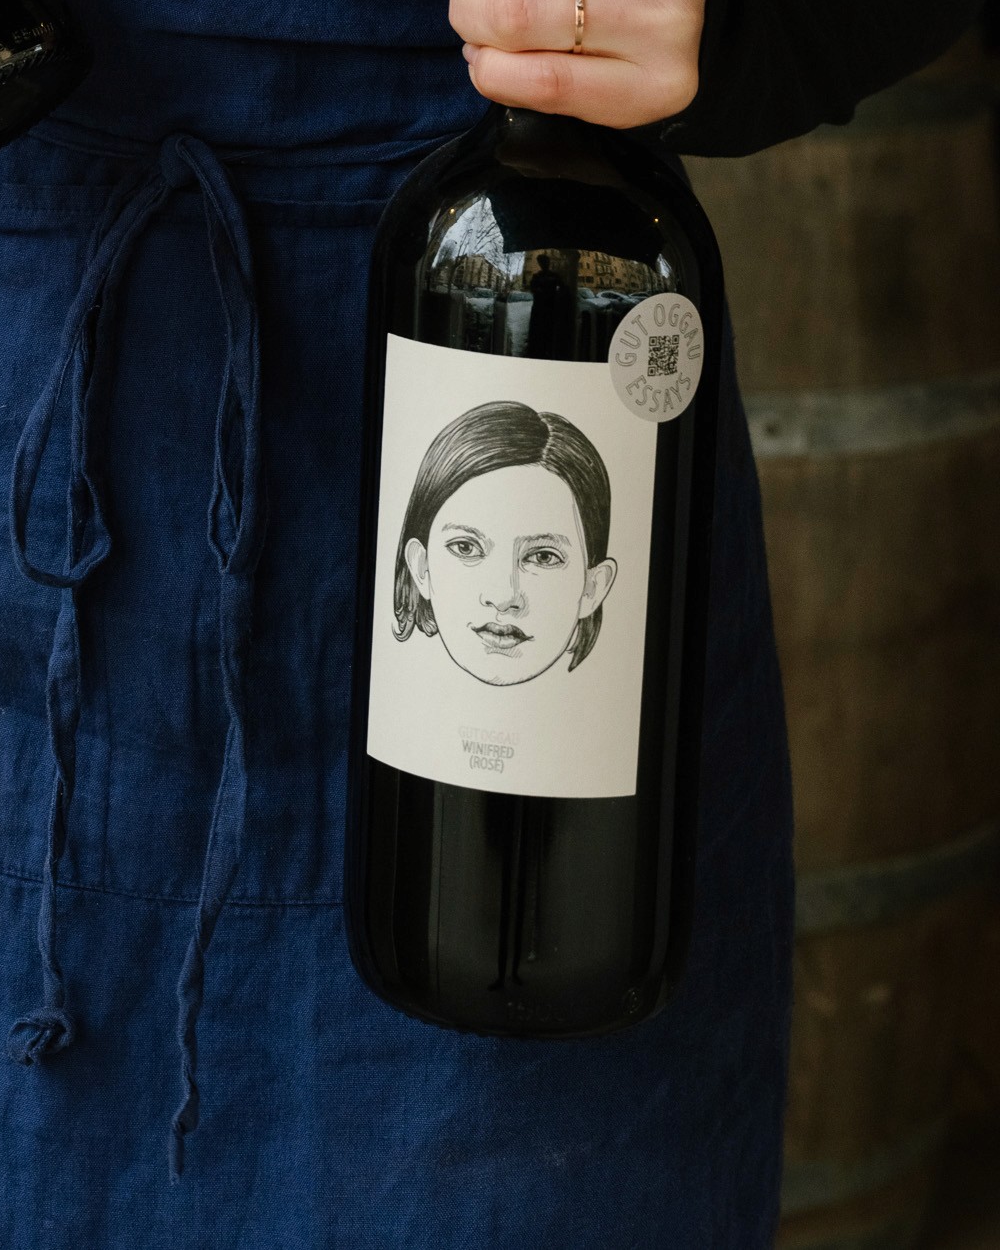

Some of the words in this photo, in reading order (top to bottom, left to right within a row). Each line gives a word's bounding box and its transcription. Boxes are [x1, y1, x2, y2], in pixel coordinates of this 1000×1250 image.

[615, 314, 648, 367] GUT
[653, 303, 701, 360] OGGAU
[625, 373, 691, 413] ESSAYS
[462, 740, 514, 758] WINIFRED
